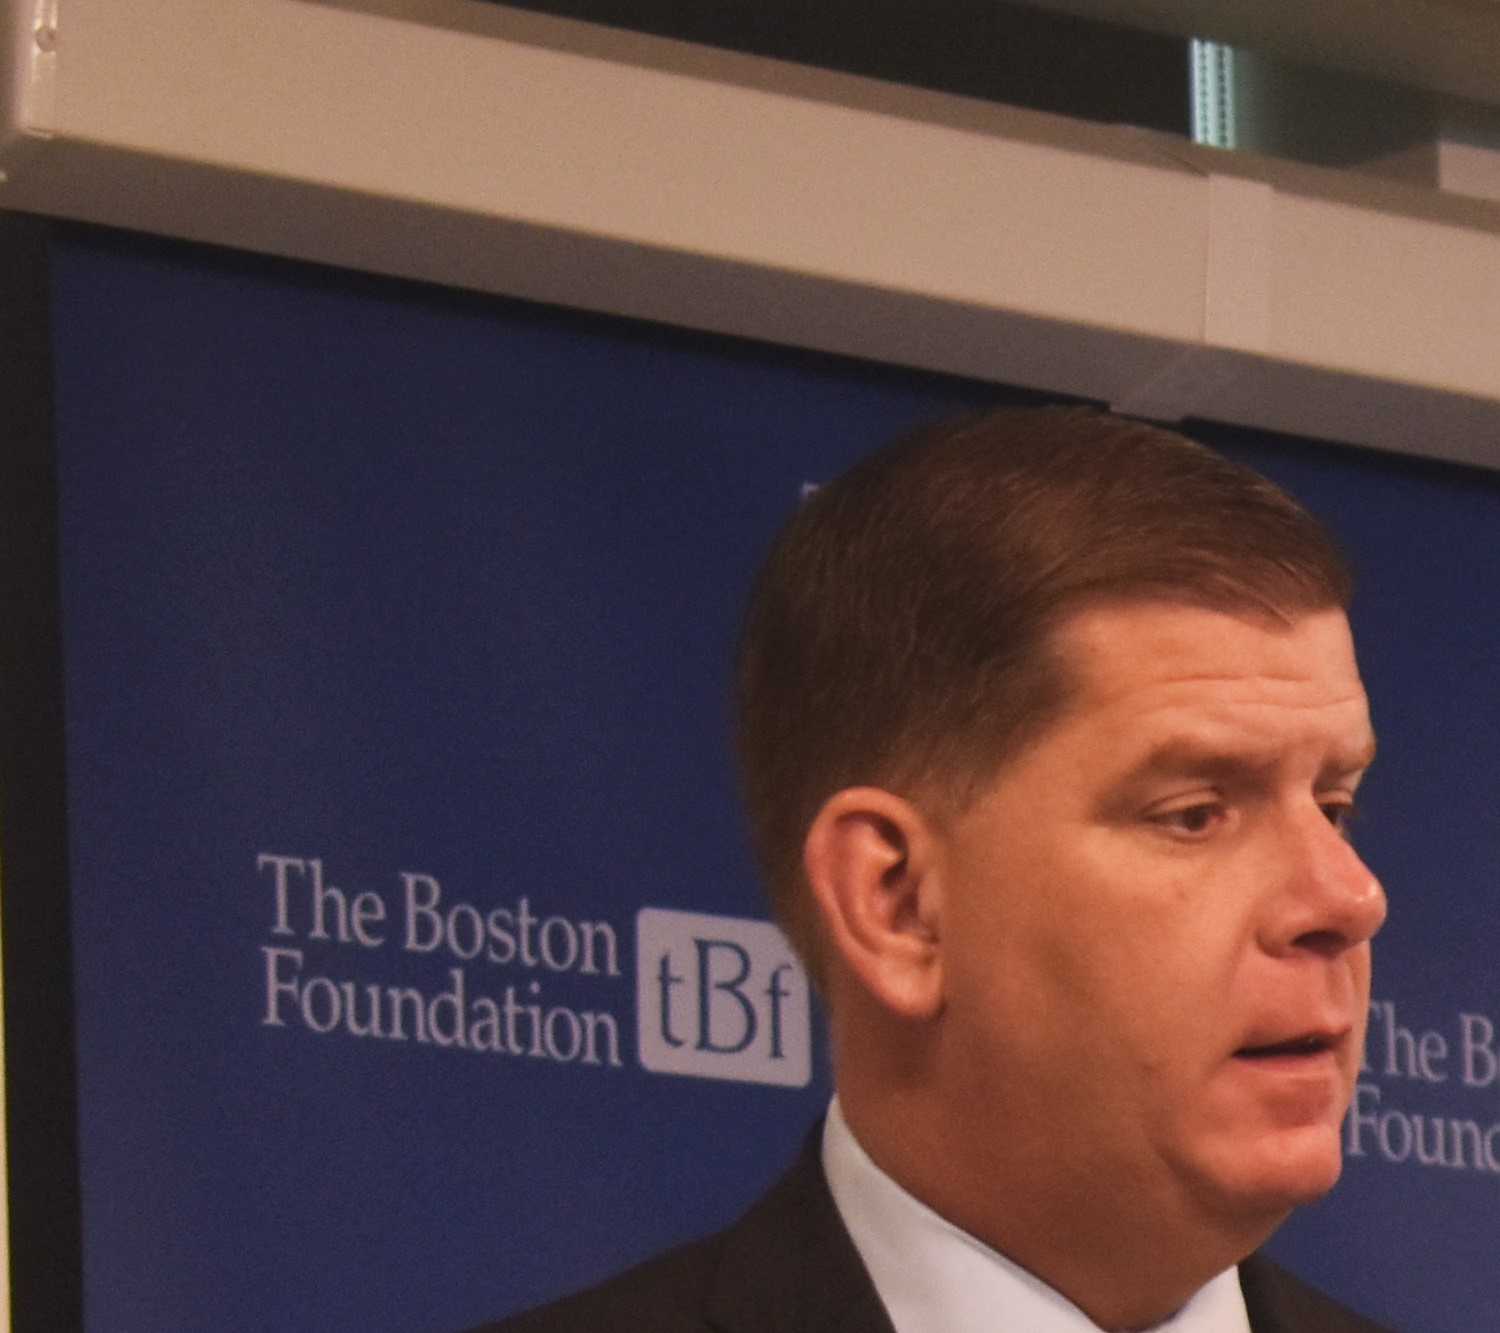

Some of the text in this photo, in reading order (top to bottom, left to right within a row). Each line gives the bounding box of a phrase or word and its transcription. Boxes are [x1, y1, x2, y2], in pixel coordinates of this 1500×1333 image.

[257, 852, 620, 976] The Boston
[261, 946, 622, 1066] Foundation
